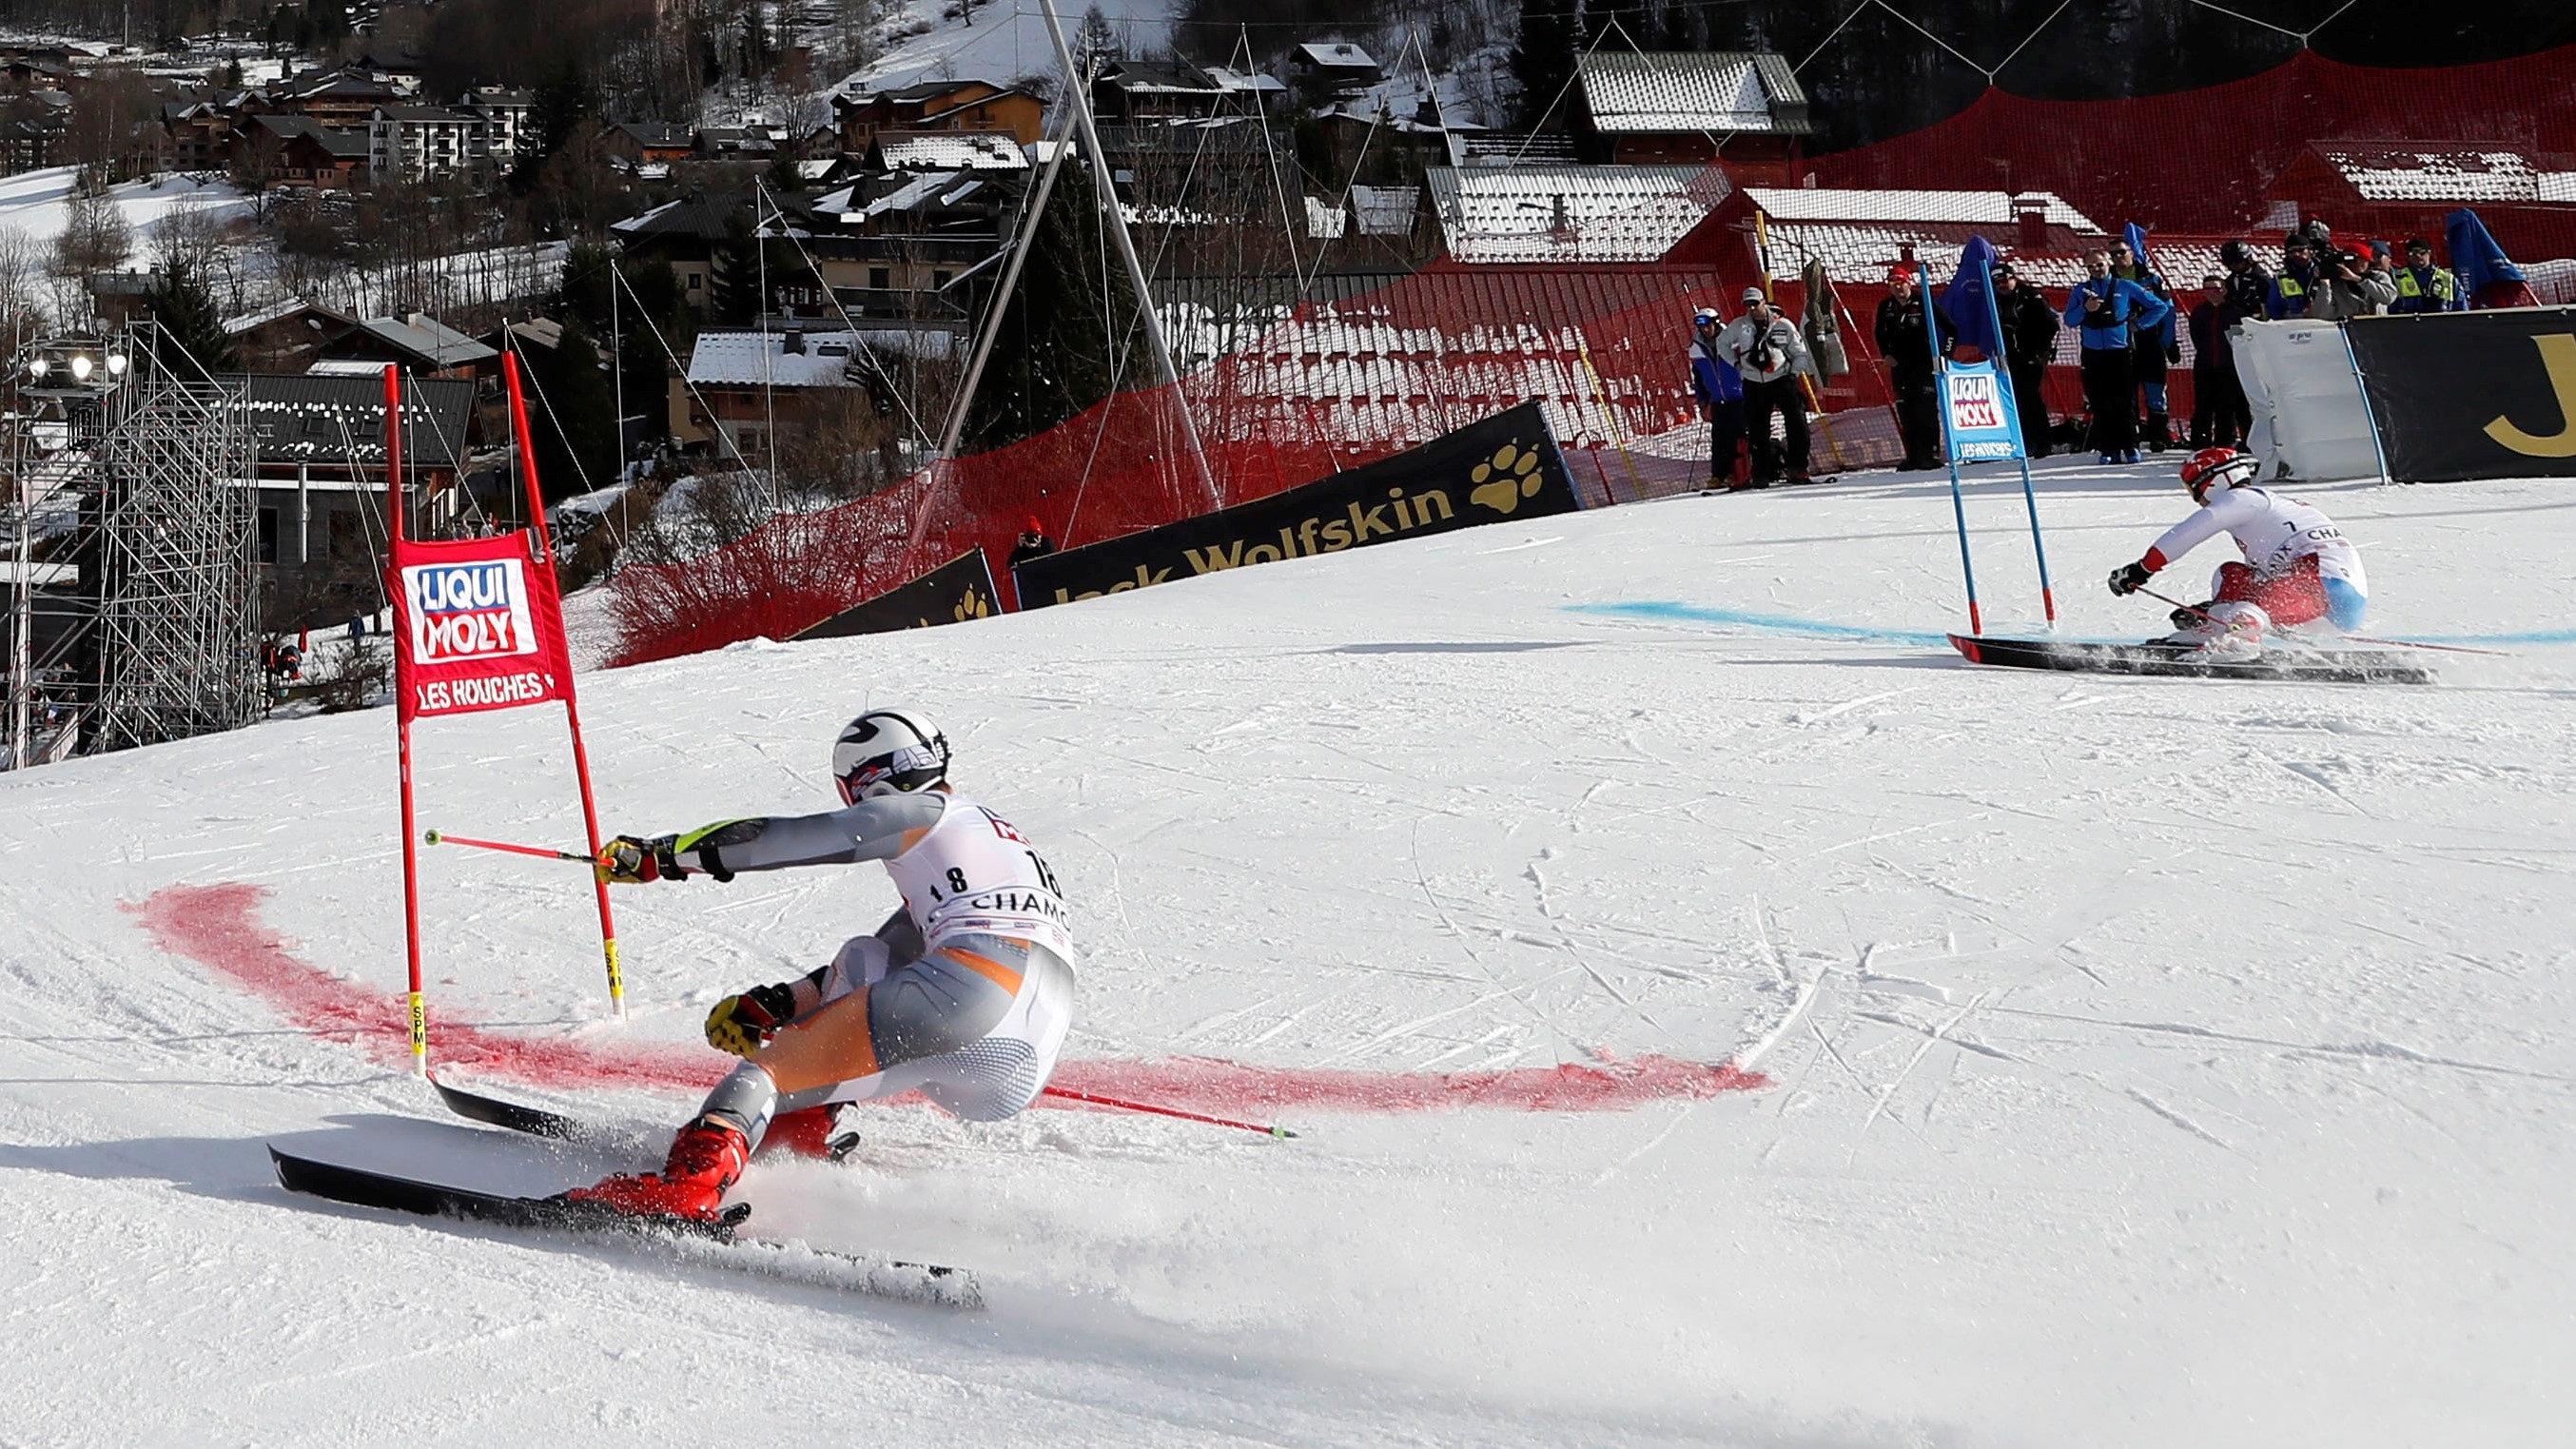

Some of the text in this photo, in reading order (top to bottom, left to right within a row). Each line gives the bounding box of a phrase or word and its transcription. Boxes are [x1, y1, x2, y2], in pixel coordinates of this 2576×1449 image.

[1954, 378, 1988, 401] LIQUI
[1955, 402, 1994, 426] MOLY
[1182, 487, 1454, 574] Wolfskin
[421, 566, 505, 610] LIQUI
[426, 612, 512, 656] MOLY
[417, 673, 544, 710] LES HOUCHES
